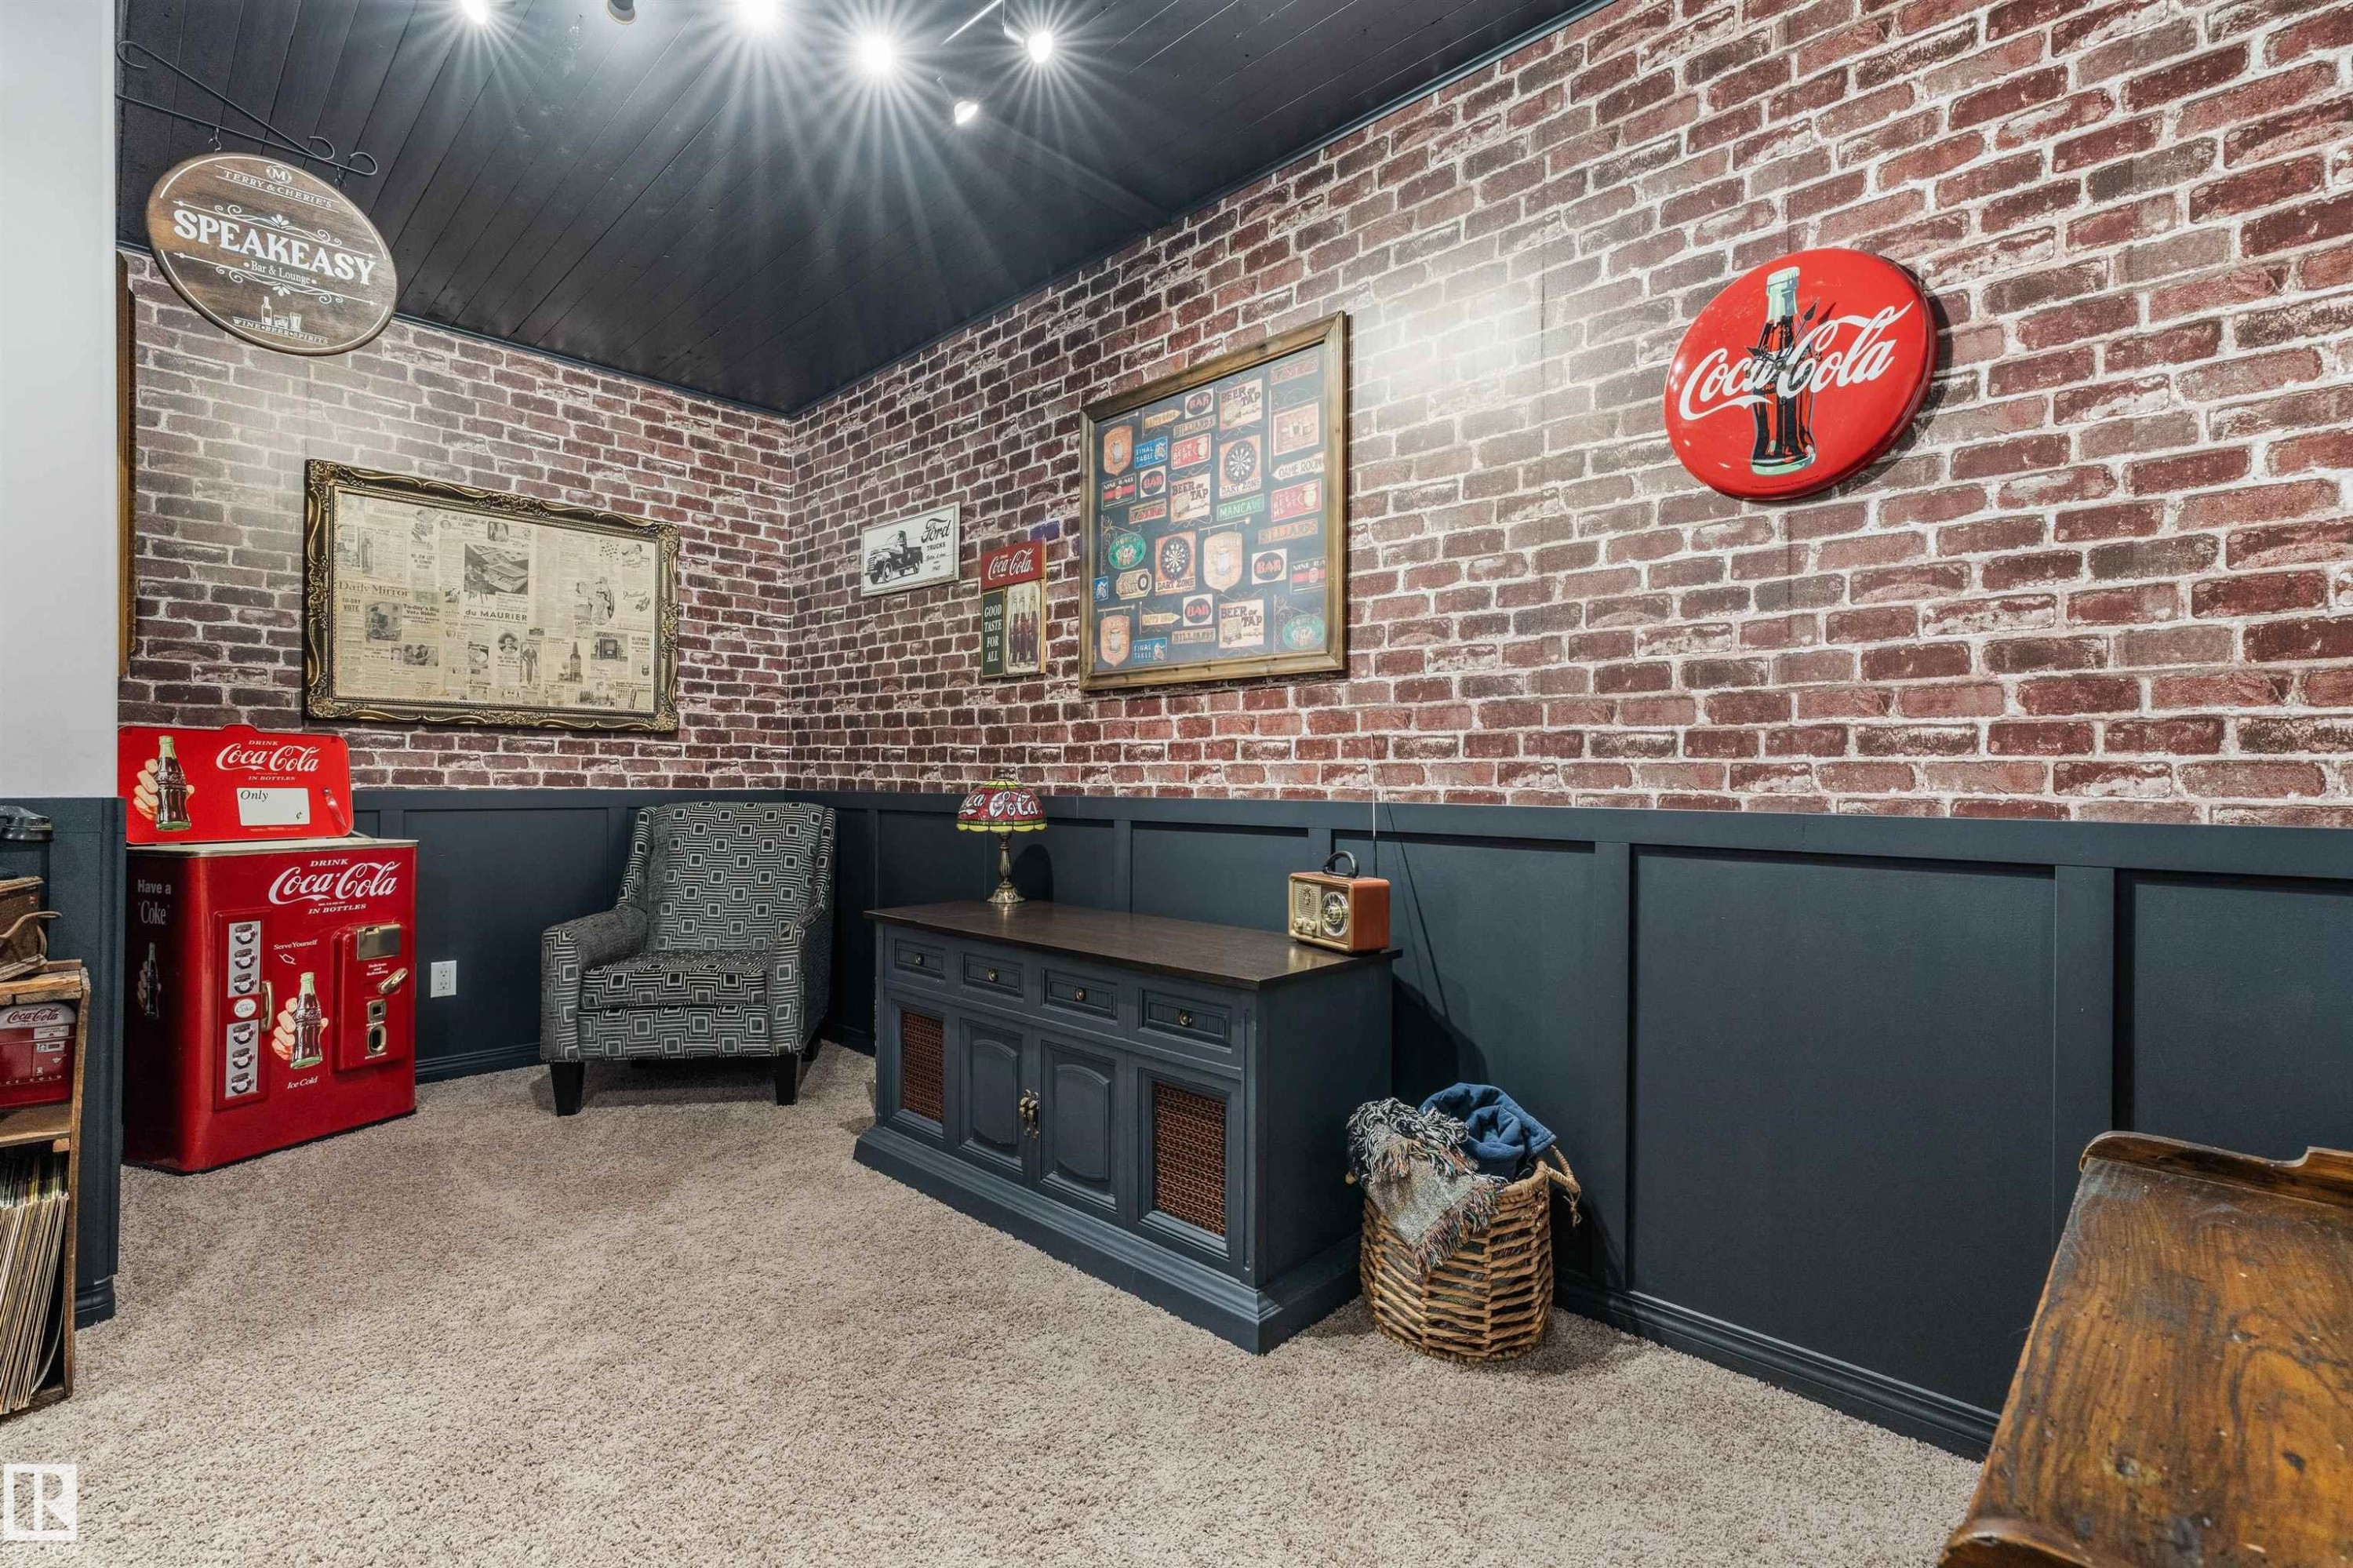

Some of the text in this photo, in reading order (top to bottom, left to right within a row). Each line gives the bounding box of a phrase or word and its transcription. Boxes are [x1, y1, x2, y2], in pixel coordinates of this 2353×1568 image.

[273, 169, 286, 180] M
[224, 170, 264, 187] TERRY
[278, 186, 332, 209] CHERIE'S
[173, 209, 376, 286] SPEAKEASY
[251, 260, 311, 285] Bar & Lounge
[233, 318, 329, 344] WINE BEER SPIRITS
[1221, 387, 1246, 403] BEER
[1241, 391, 1261, 406] TAP
[1136, 446, 1154, 455] FINAL
[1136, 454, 1153, 463] TABLE
[1144, 475, 1162, 489] BAR
[1172, 482, 1195, 496] BEER
[1221, 483, 1239, 495] DART
[1190, 488, 1209, 501] TAP
[921, 518, 951, 543] Ford
[926, 541, 946, 551] TRUCKS
[988, 548, 1035, 580] Coca-Cola
[1257, 559, 1282, 574] BAR
[339, 581, 411, 596] Daily Mirror
[480, 610, 528, 621] MAURIER
[984, 604, 1002, 618] GOOD
[1220, 606, 1248, 619] BEER
[984, 619, 1002, 632] TASTE
[1241, 616, 1263, 627] TAP
[987, 635, 999, 648] FOR
[987, 650, 999, 663] ALL
[216, 743, 321, 772] Coca-Cola
[240, 790, 269, 802] Only
[309, 858, 349, 867] DRINK
[137, 879, 172, 895] Have a
[267, 861, 402, 904] Coca-Cola
[322, 904, 366, 913] BOTTLES
[292, 939, 318, 948] Yourself
[7, 1007, 62, 1024] Coca-Cola
[287, 1076, 319, 1090] Ice Cold
